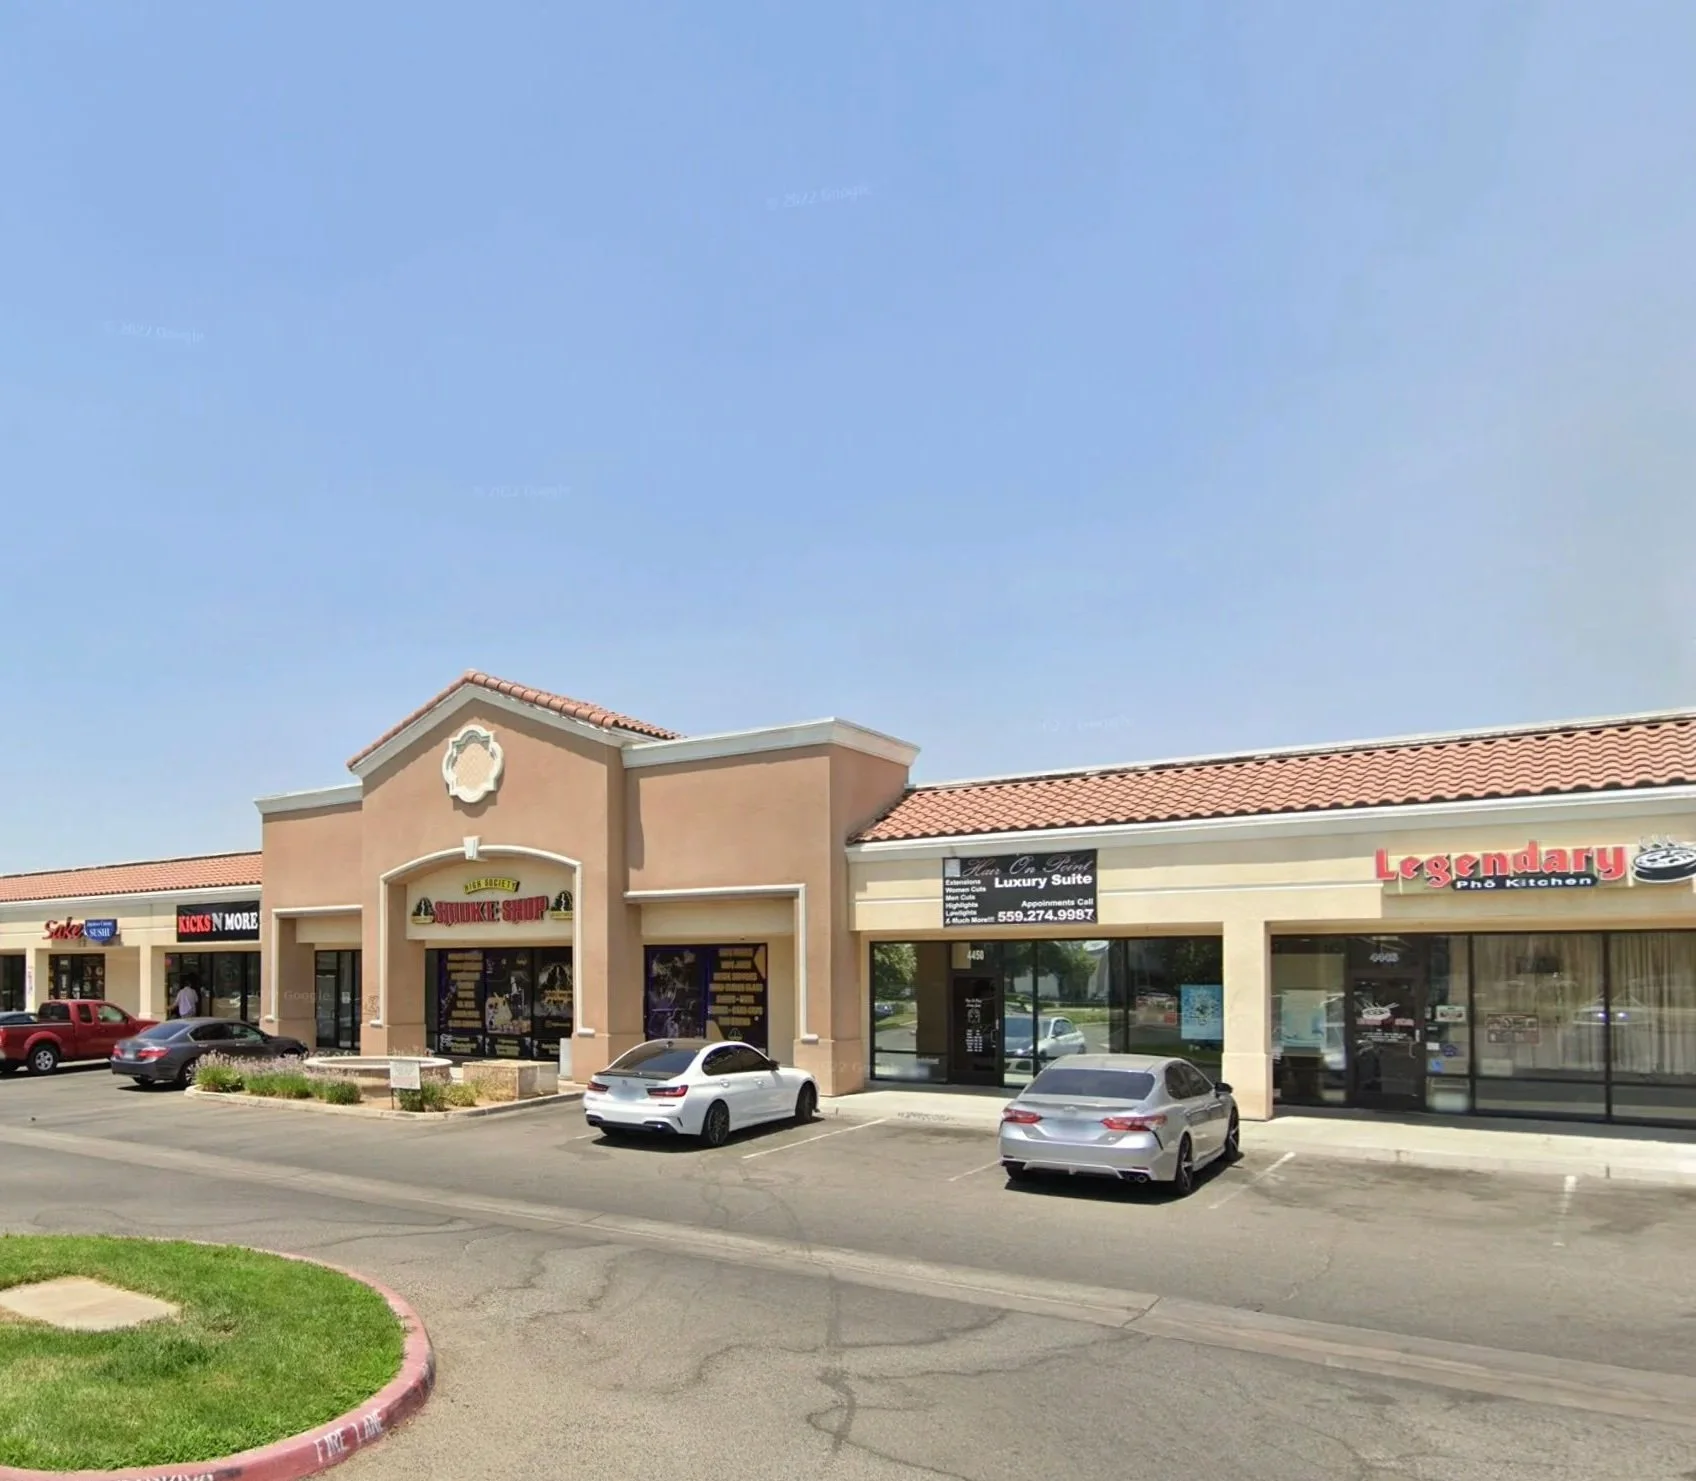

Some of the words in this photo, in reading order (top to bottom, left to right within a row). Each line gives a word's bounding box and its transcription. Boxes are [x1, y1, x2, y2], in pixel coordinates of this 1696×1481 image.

[1009, 855, 1036, 875] On
[1375, 840, 1626, 889] Legendary
[945, 879, 981, 887] Extensions
[995, 877, 1047, 890] Luxury
[1051, 873, 1092, 886] Suite
[1506, 877, 1592, 888] Kitchen
[435, 901, 500, 924] SMOKE
[502, 896, 549, 922] SHOP
[1077, 898, 1094, 906] Call
[211, 912, 223, 932] N
[224, 911, 258, 931] MORE
[997, 908, 1094, 922] 559.274.9987
[313, 1428, 349, 1463] FIRE
